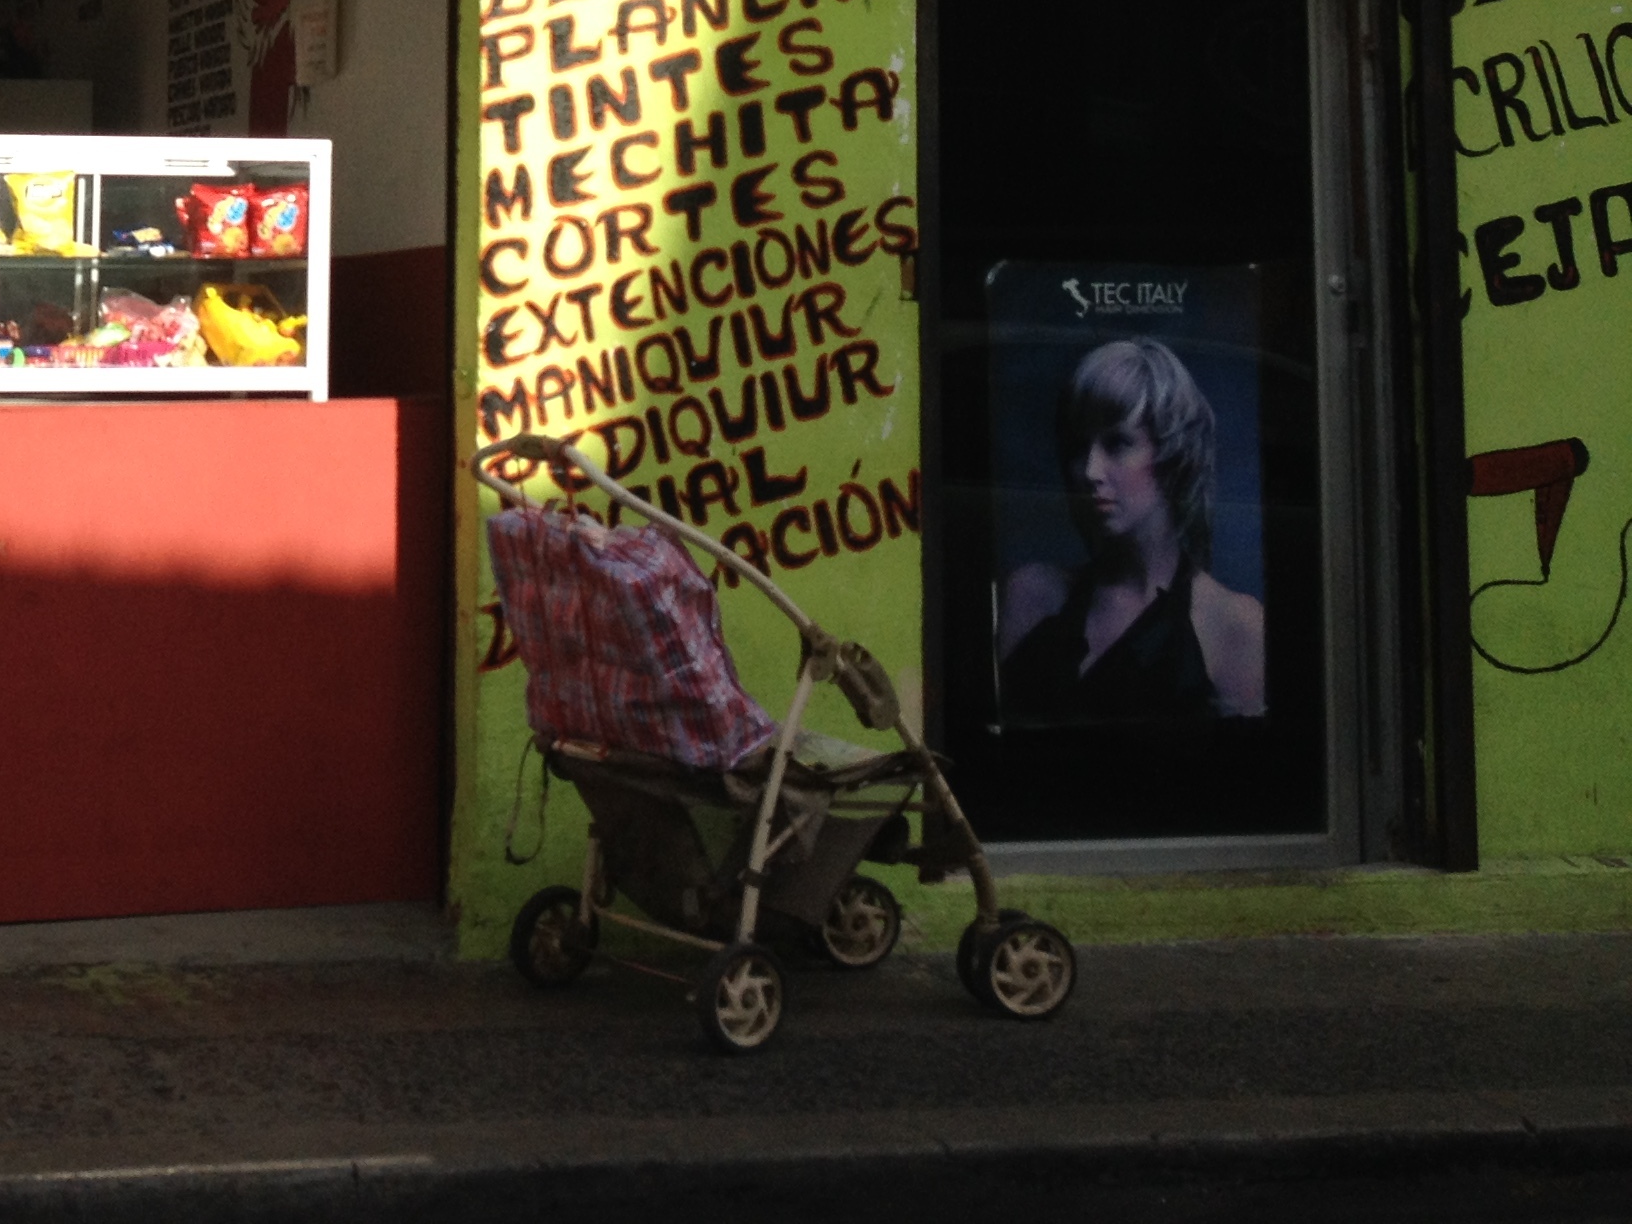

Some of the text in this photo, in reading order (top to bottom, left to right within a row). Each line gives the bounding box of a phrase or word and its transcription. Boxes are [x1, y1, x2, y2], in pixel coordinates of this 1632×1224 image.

[481, 17, 835, 154] TINTES
[484, 67, 900, 228] MECHITA
[479, 149, 846, 298] CORTES
[481, 196, 918, 369] EXTENCIONES
[1090, 278, 1189, 305] TEC ITALY
